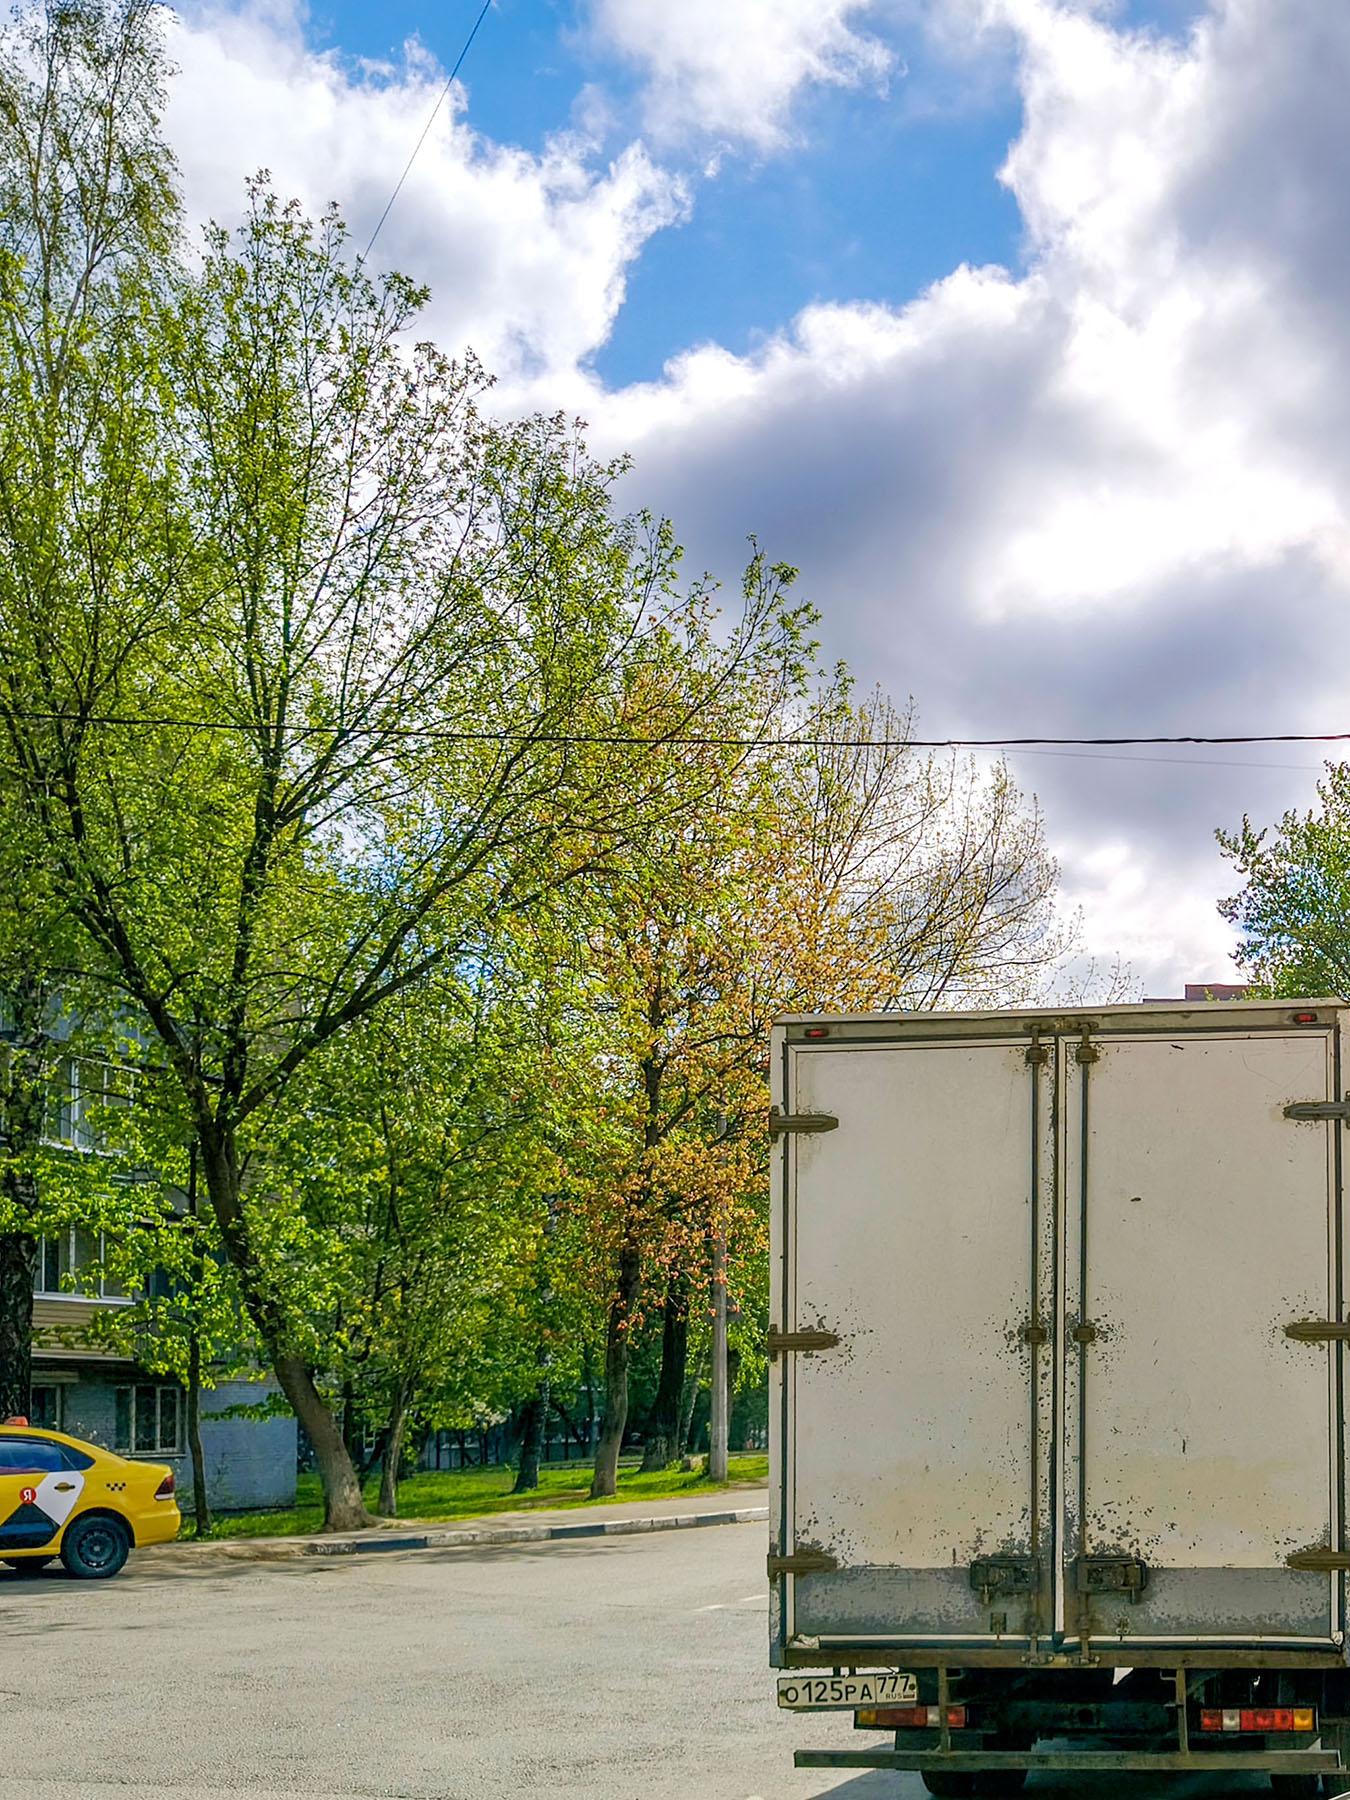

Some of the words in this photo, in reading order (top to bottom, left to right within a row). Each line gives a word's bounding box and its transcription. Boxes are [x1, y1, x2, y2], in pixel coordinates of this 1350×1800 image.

[23, 1489, 32, 1501] Я
[877, 1676, 910, 1693] 777
[885, 1692, 903, 1700] RUS
